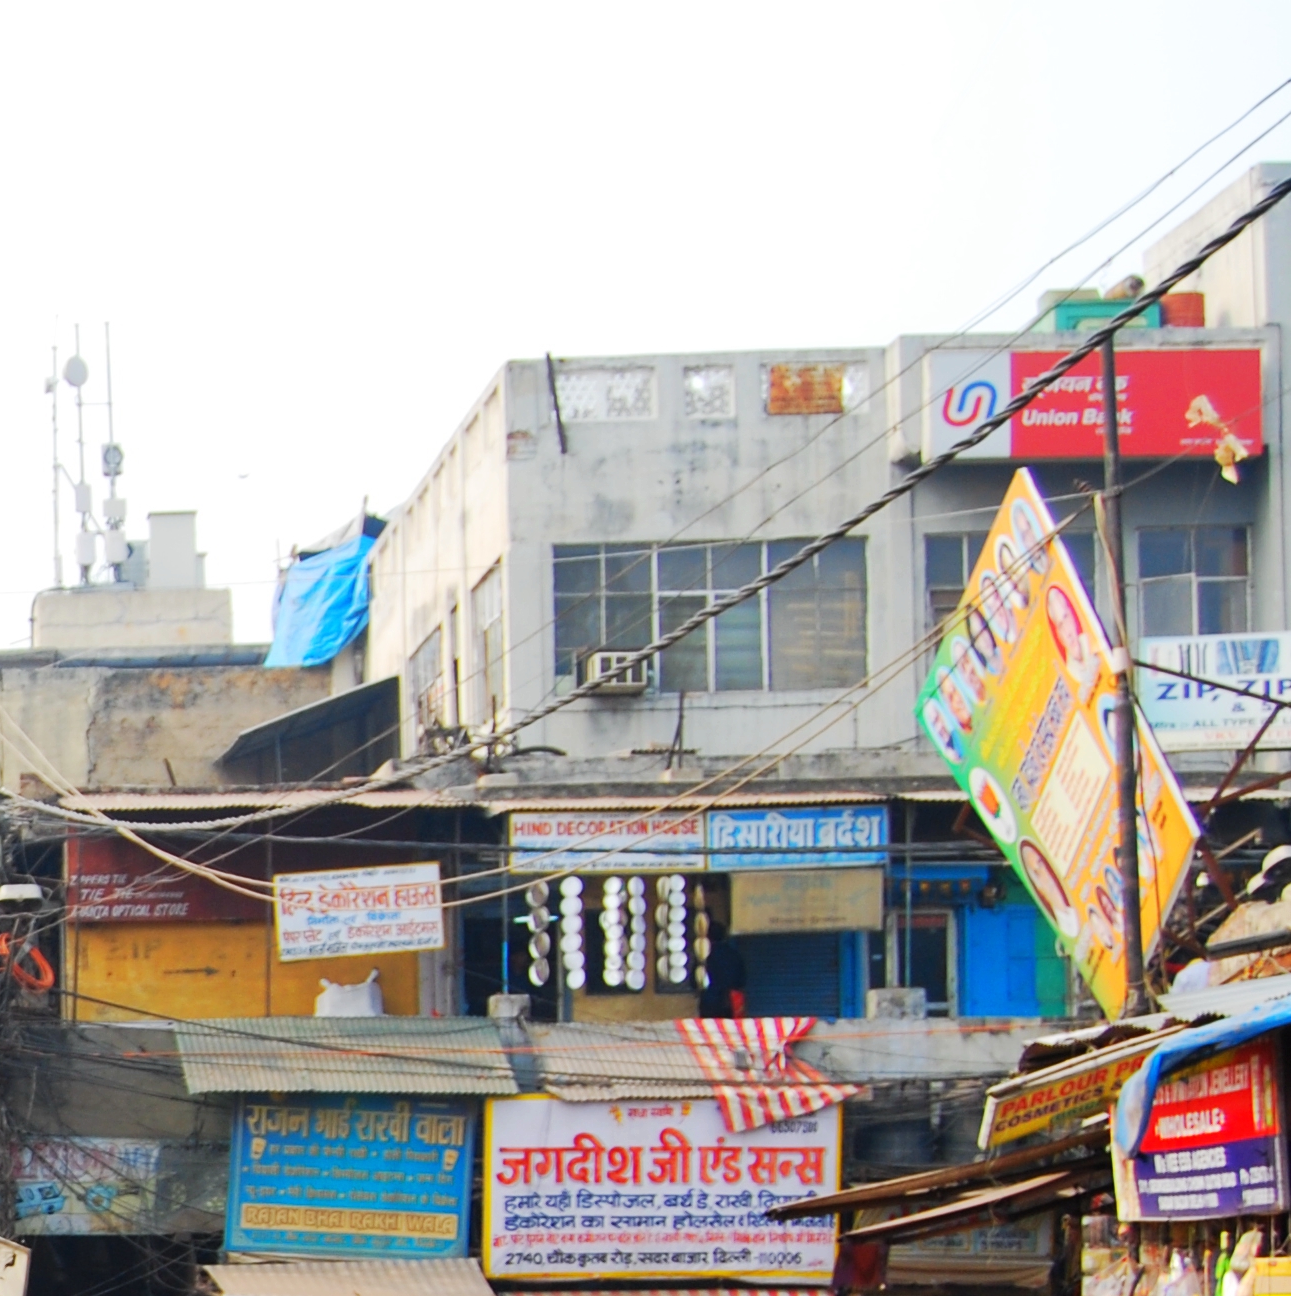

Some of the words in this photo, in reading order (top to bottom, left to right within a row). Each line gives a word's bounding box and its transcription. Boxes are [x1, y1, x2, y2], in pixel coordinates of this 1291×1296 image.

[1021, 408, 1079, 427] Union
[1081, 408, 1133, 426] Bak
[513, 820, 552, 837] HIND
[556, 819, 649, 837] DECORATION
[651, 817, 700, 836] HOUSE
[111, 903, 151, 917] OPTICAL
[152, 901, 190, 917] STORE
[1000, 1067, 1109, 1119] PARLOUR
[245, 1103, 310, 1139] राजन
[314, 1097, 356, 1140] भाई
[355, 1100, 412, 1143] राखी
[414, 1112, 468, 1146] वाला
[994, 1084, 1105, 1133] COSMETICS
[1158, 1107, 1223, 1140] WHOLESALE
[496, 1132, 644, 1185] जगदीश
[647, 1127, 693, 1185] जी
[697, 1136, 743, 1186] एंड
[747, 1146, 827, 1186] सन्स
[504, 1190, 542, 1214] हमारे
[245, 1206, 300, 1226] RAJAN
[303, 1209, 345, 1228] BHAI
[349, 1212, 399, 1231] RAKHI
[404, 1215, 455, 1234] WALA
[504, 1211, 577, 1232] डेकोरेशन
[581, 1214, 605, 1229] का
[610, 1214, 667, 1229] सामान
[672, 1210, 736, 1230] होलसेल
[546, 1247, 577, 1265] चौक
[637, 1251, 669, 1265] सदर
[670, 1251, 709, 1265] बाजार
[712, 1247, 753, 1264] दिल्ली
